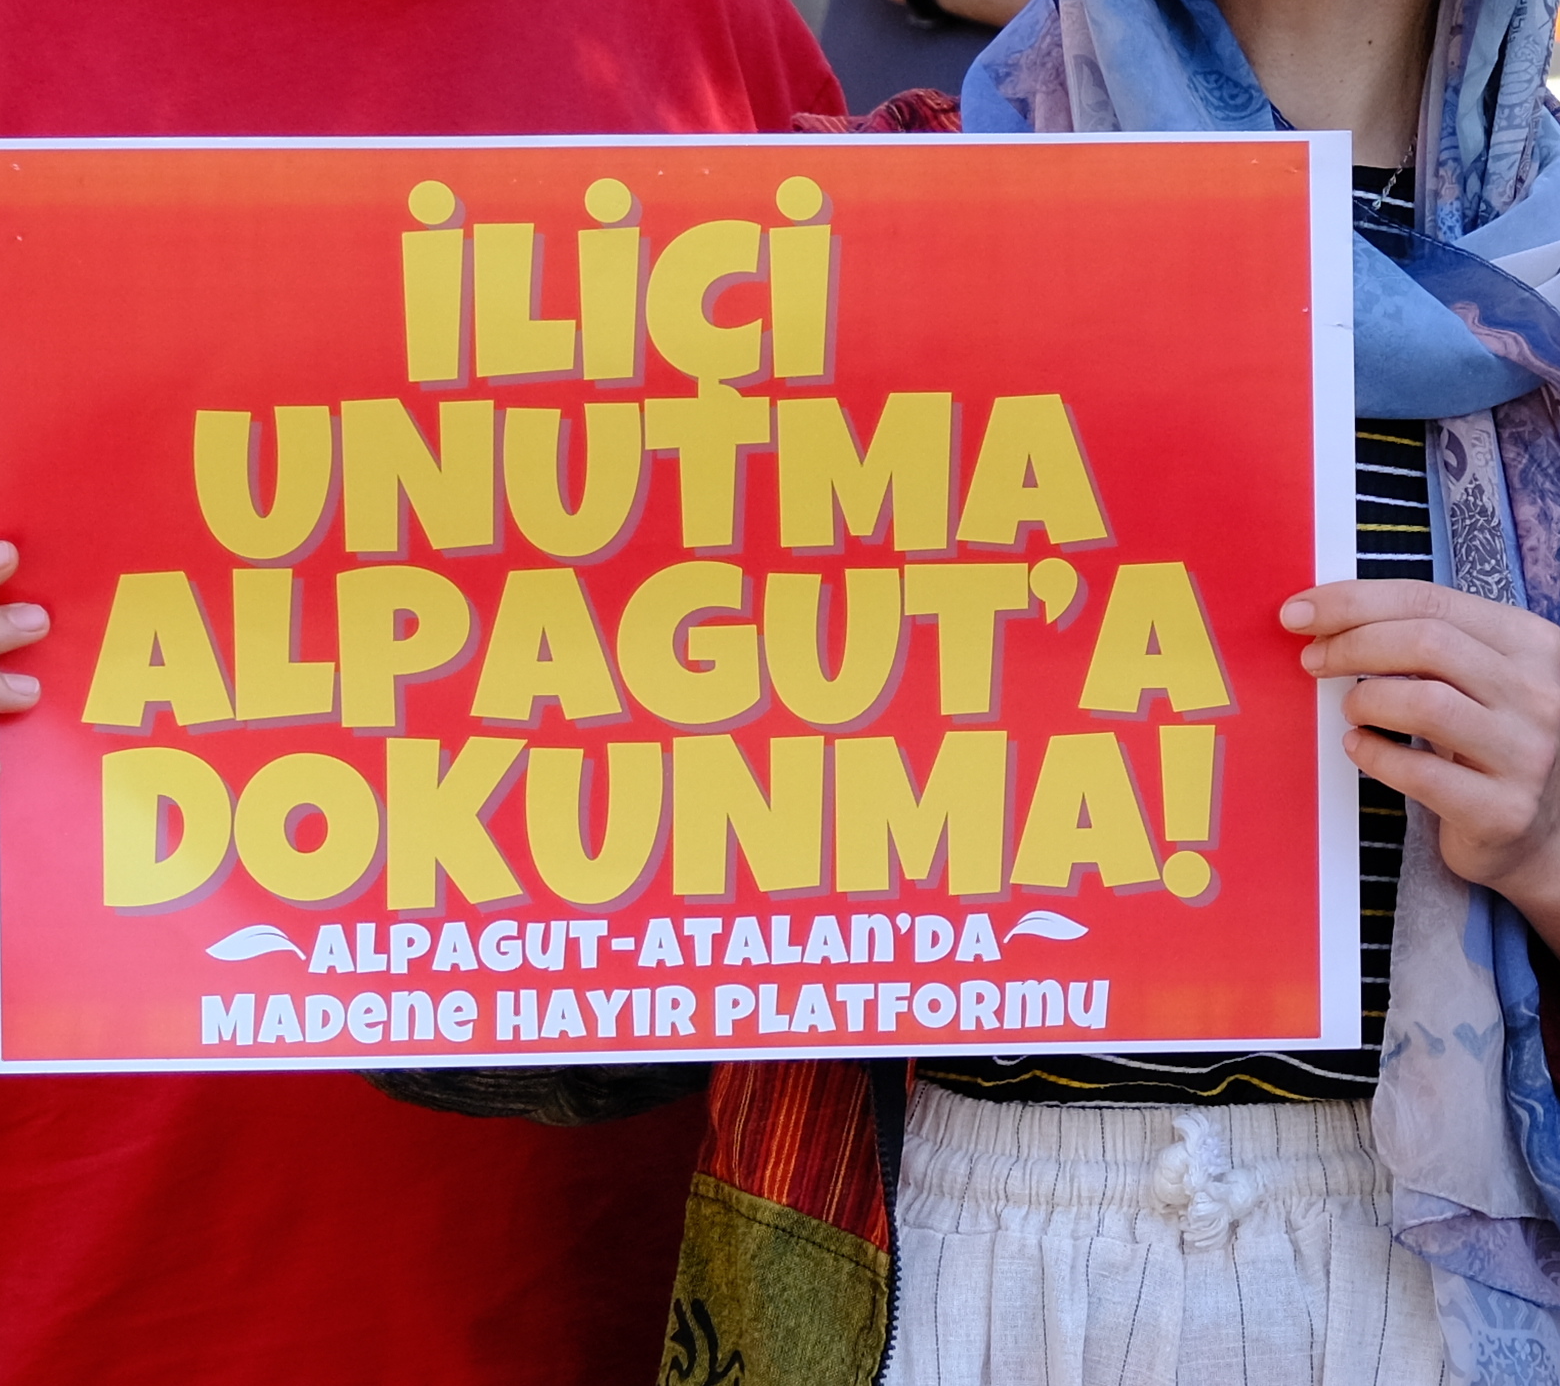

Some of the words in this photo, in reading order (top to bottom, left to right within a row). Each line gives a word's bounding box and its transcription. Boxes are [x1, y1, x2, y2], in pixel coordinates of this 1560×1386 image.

[400, 175, 834, 397] İLİÇİ
[194, 391, 1106, 561] UNUTMA
[81, 557, 1230, 728] ALPAGUT'A
[100, 723, 1221, 911] DOKUNMA!
[496, 985, 697, 1039] HAYIR
